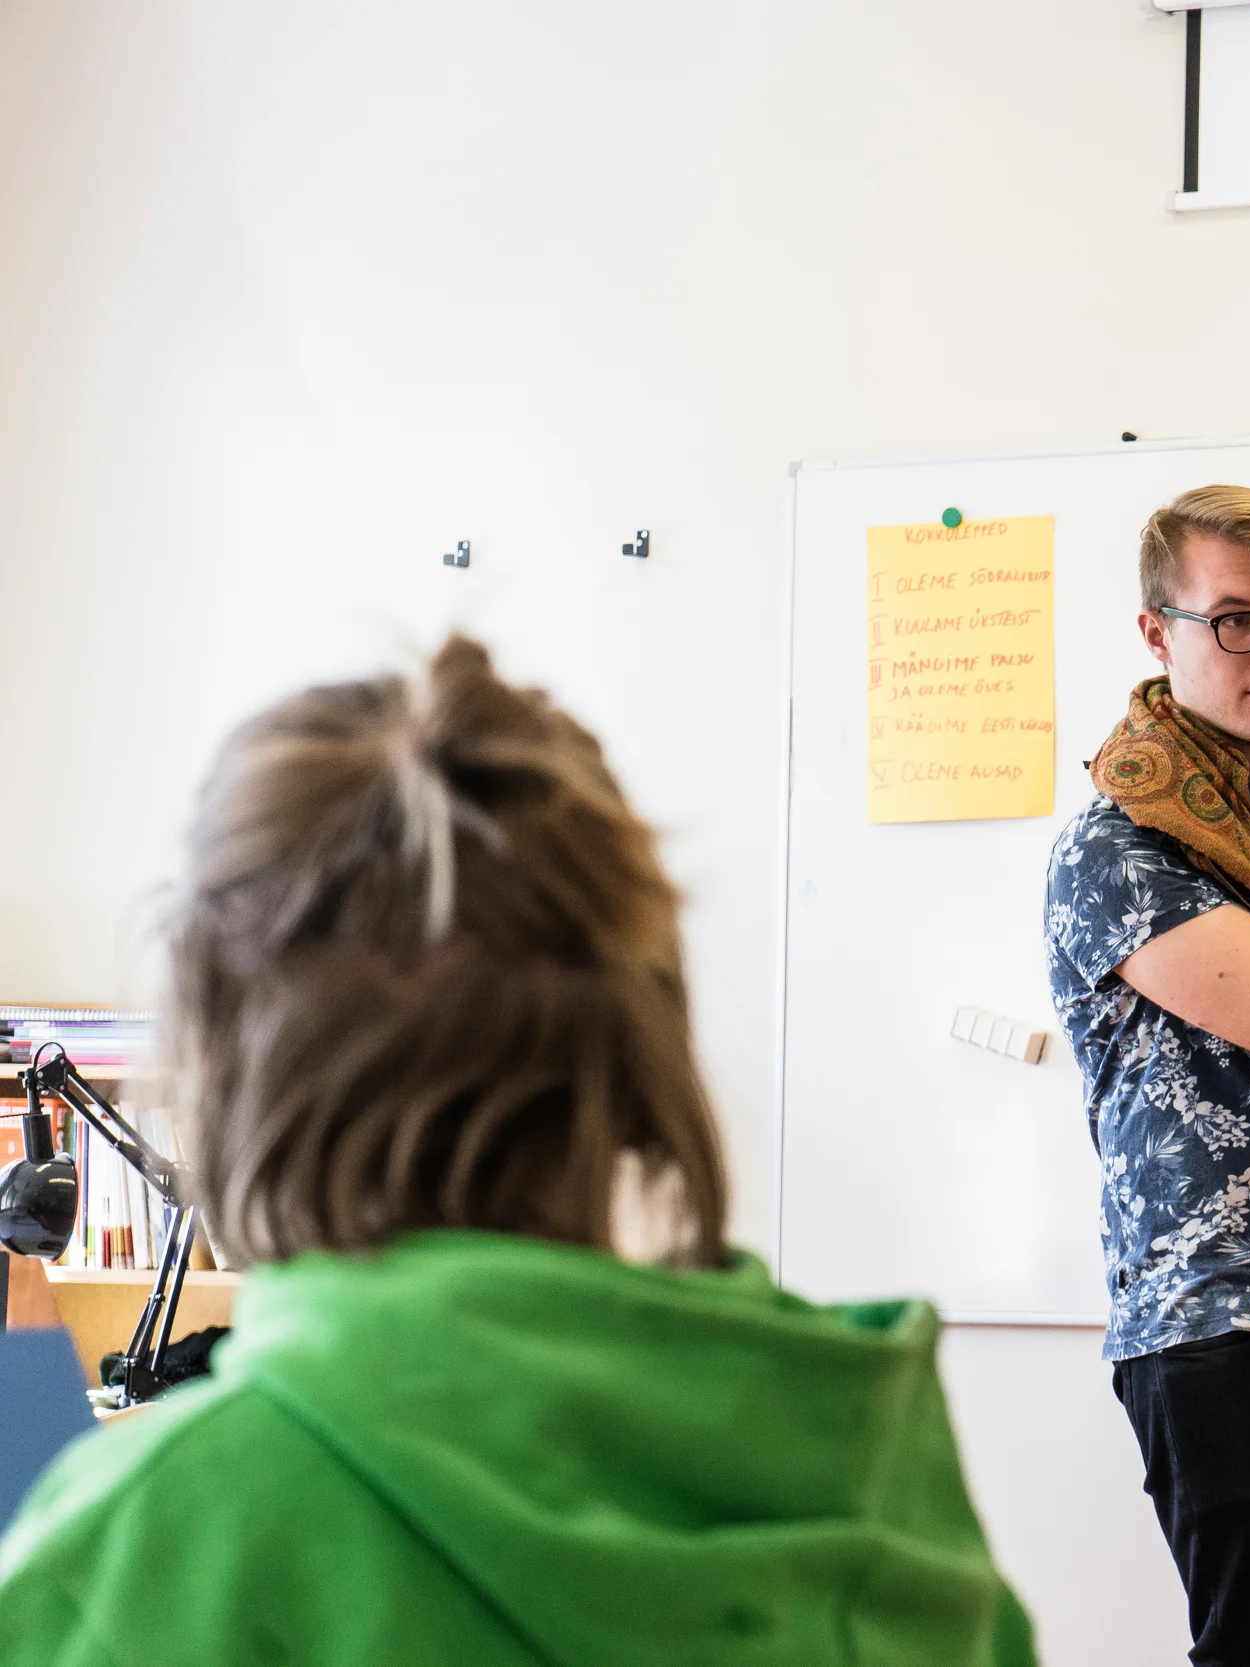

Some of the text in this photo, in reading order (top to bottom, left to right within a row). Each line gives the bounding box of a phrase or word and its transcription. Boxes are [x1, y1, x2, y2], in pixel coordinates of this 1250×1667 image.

[895, 572, 957, 595] OLEME
[893, 614, 965, 638] KUULAME
[892, 651, 980, 679] MÄNGIME
[990, 653, 1035, 669] PALJU
[887, 686, 912, 702] JA
[918, 682, 969, 698] OLEME
[900, 761, 965, 784] OLEME
[969, 761, 1023, 782] AUSAD
